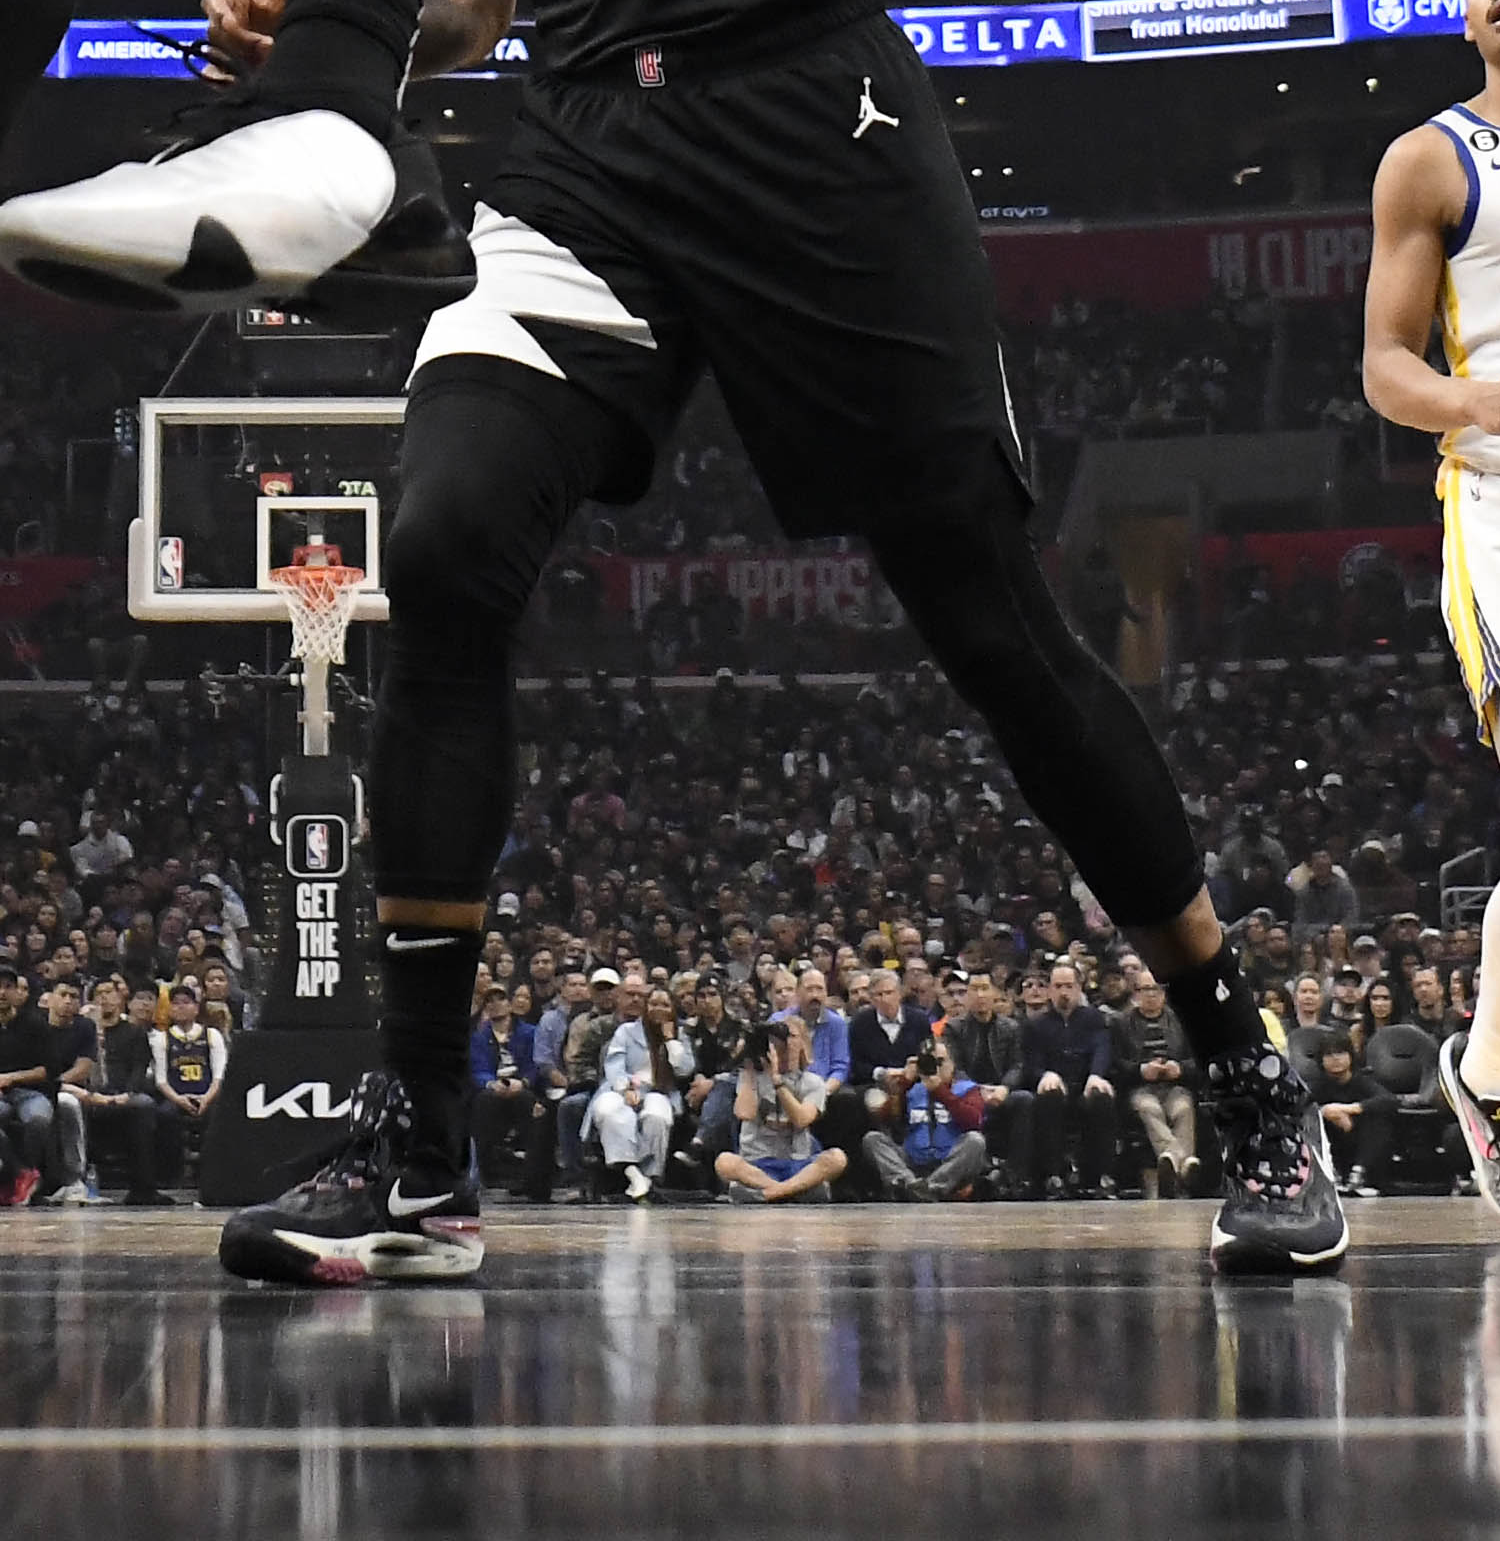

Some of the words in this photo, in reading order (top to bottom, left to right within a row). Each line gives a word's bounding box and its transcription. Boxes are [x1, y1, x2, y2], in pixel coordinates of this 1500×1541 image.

[908, 18, 1067, 54] DELTA
[1130, 14, 1182, 40] from
[1474, 132, 1495, 151] 6
[1259, 228, 1371, 296] CLIPP
[296, 881, 339, 919] GET
[296, 921, 340, 958] THE
[295, 960, 340, 998] APP
[179, 1064, 203, 1082] 30
